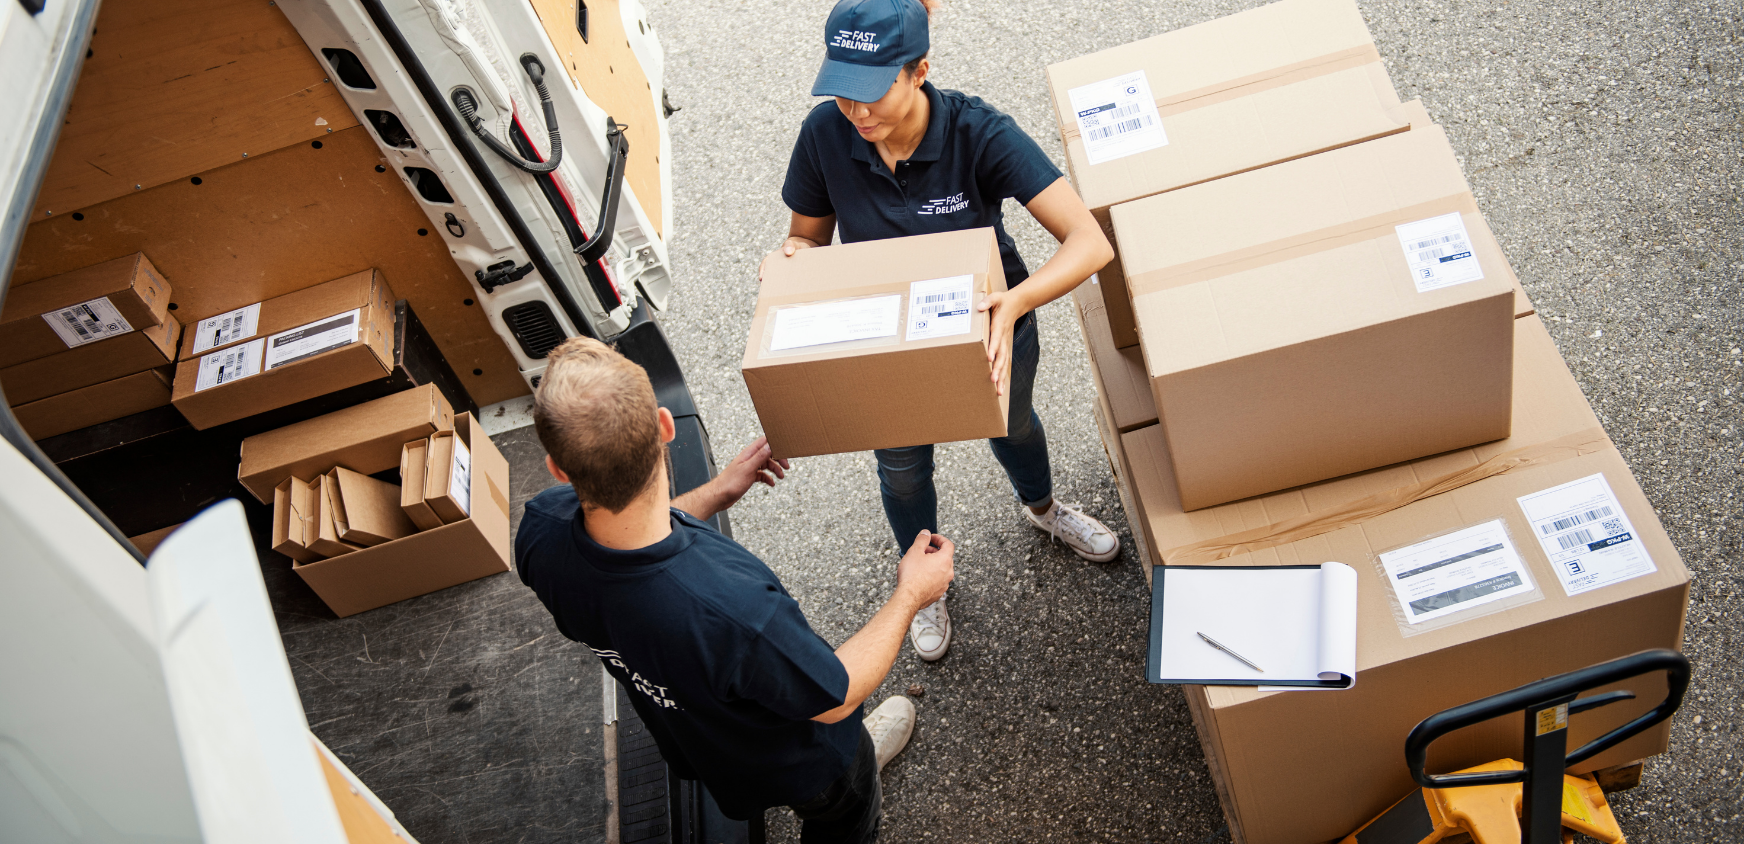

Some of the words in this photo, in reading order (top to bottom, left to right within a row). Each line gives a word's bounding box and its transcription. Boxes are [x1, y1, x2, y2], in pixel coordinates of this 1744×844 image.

[852, 31, 876, 42] FAST
[841, 39, 880, 52] DELIVERY
[1126, 86, 1136, 94] G
[946, 192, 963, 205] FAST
[935, 200, 969, 214] DELIVERY
[1606, 533, 1630, 545] W-PKG
[1568, 562, 1581, 573] E
[1492, 581, 1515, 591] INVOICE
